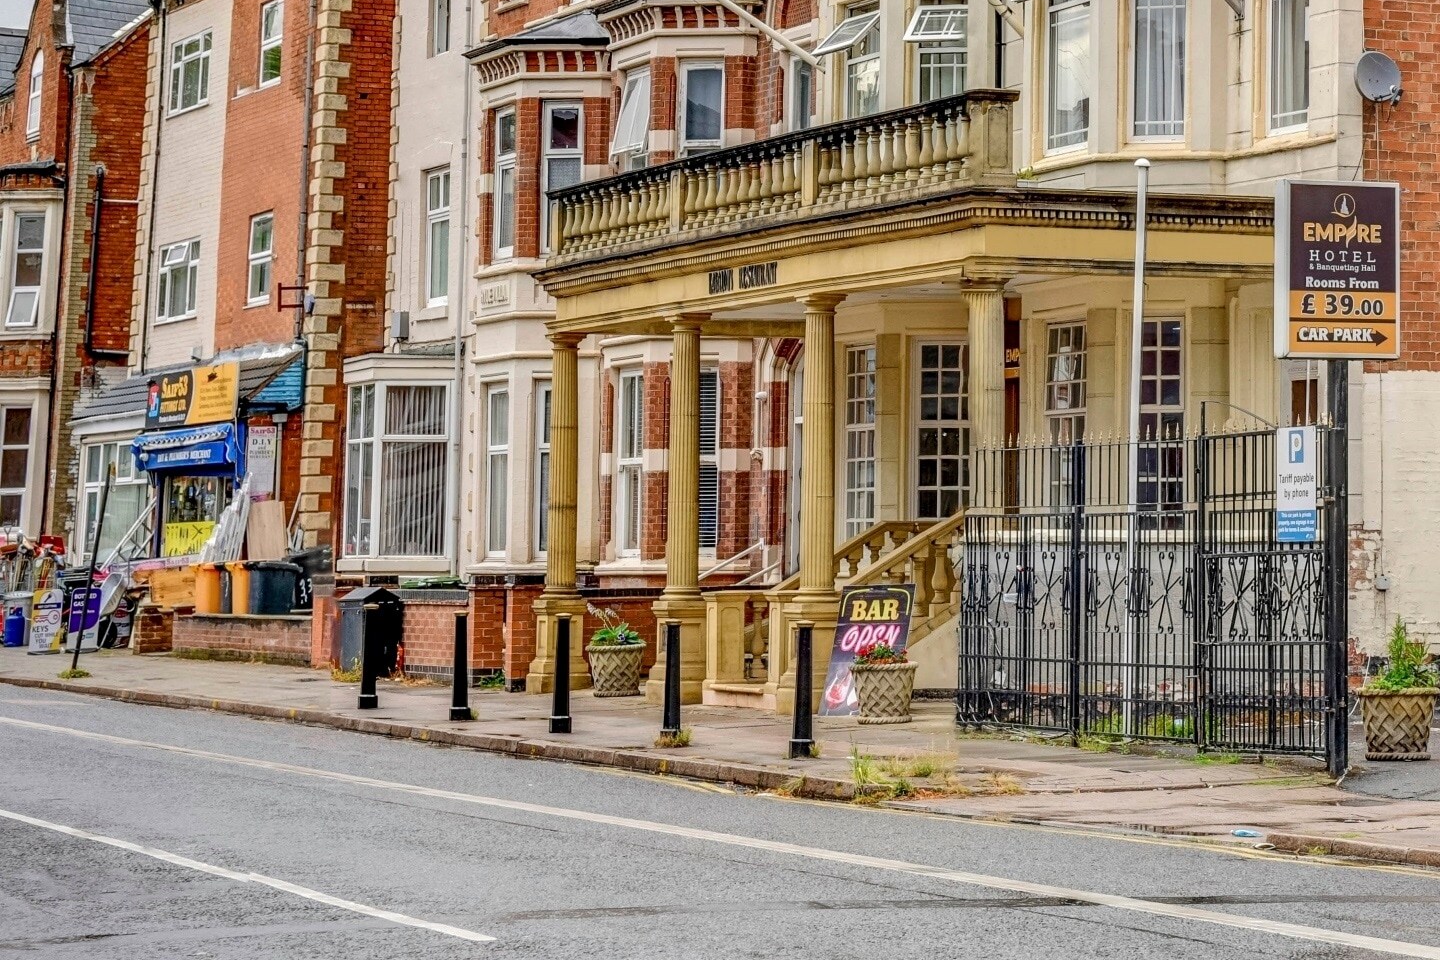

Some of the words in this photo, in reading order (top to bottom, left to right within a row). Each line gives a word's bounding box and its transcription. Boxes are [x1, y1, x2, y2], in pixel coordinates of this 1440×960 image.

[1303, 217, 1382, 247] EMPIRE
[1309, 250, 1376, 263] HOTEL
[1316, 263, 1360, 273] Banqueting
[1361, 264, 1376, 272] Hall
[1305, 276, 1346, 289] Rooms
[1349, 277, 1380, 289] From
[1301, 293, 1316, 315] £
[1325, 294, 1384, 316] 39.00
[1298, 326, 1330, 342] CAR
[1333, 327, 1374, 342] PARK
[1291, 433, 1302, 462] P
[1279, 474, 1293, 484] Tariff
[1293, 472, 1315, 485] payable
[1284, 489, 1290, 500] by
[1292, 488, 1309, 500] phone
[850, 599, 900, 621] BAR
[32, 625, 49, 633] KEYS
